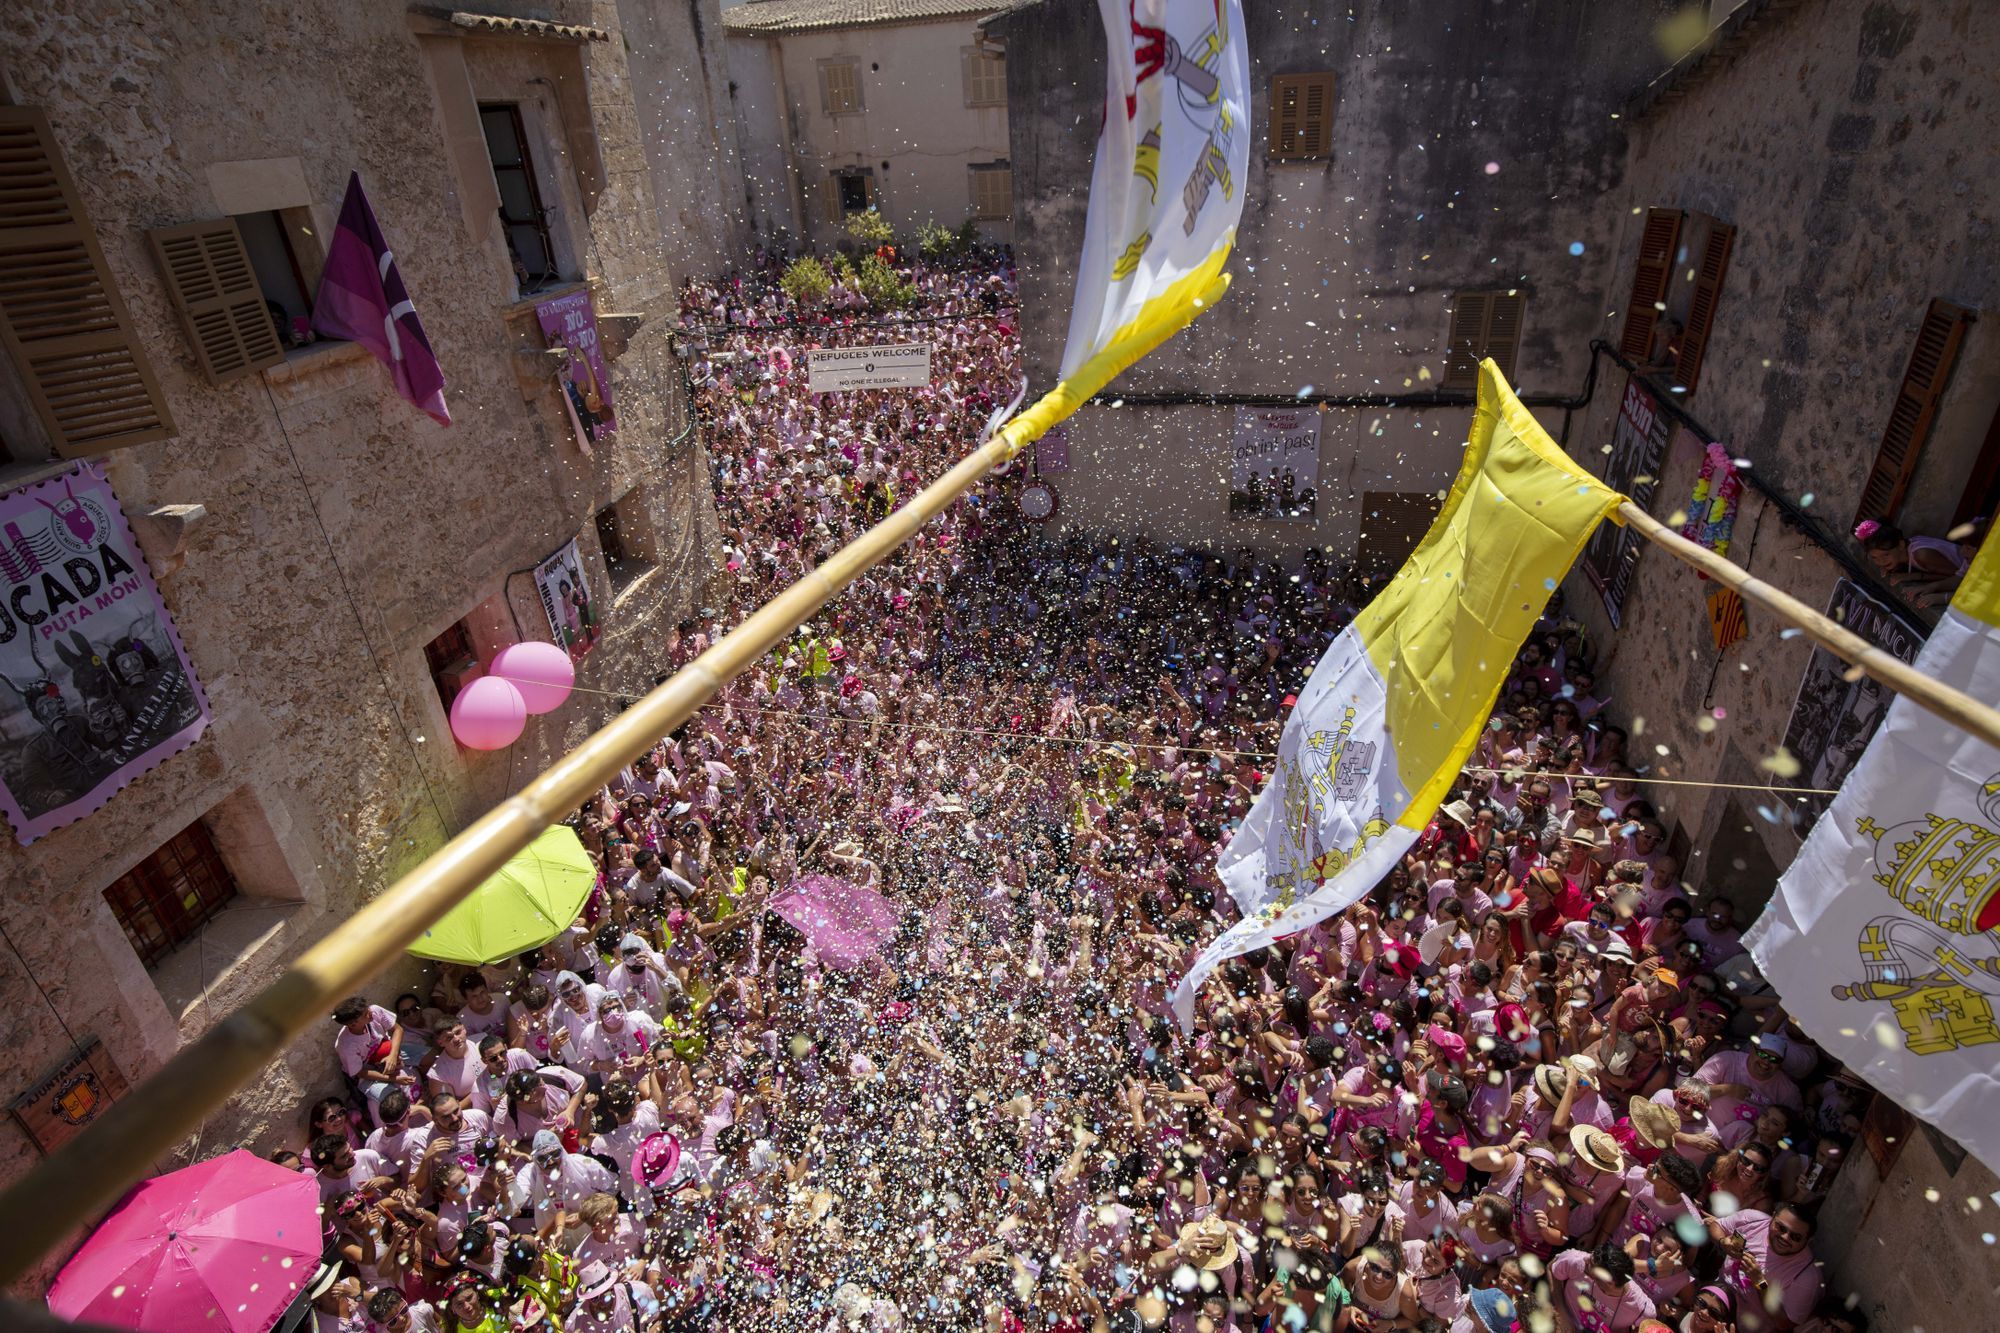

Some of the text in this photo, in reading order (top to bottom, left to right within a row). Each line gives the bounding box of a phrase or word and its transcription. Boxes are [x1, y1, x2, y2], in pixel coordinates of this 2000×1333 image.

[564, 310, 584, 332] NO
[577, 327, 597, 350] NO
[813, 347, 926, 362] REFUGEES WELCOME
[1624, 383, 1654, 436] Sun
[1284, 433, 1317, 456] pas!
[82, 501, 107, 543] AQUELL 2020
[40, 610, 94, 641] PUTA
[113, 670, 175, 765] CANCELLED
